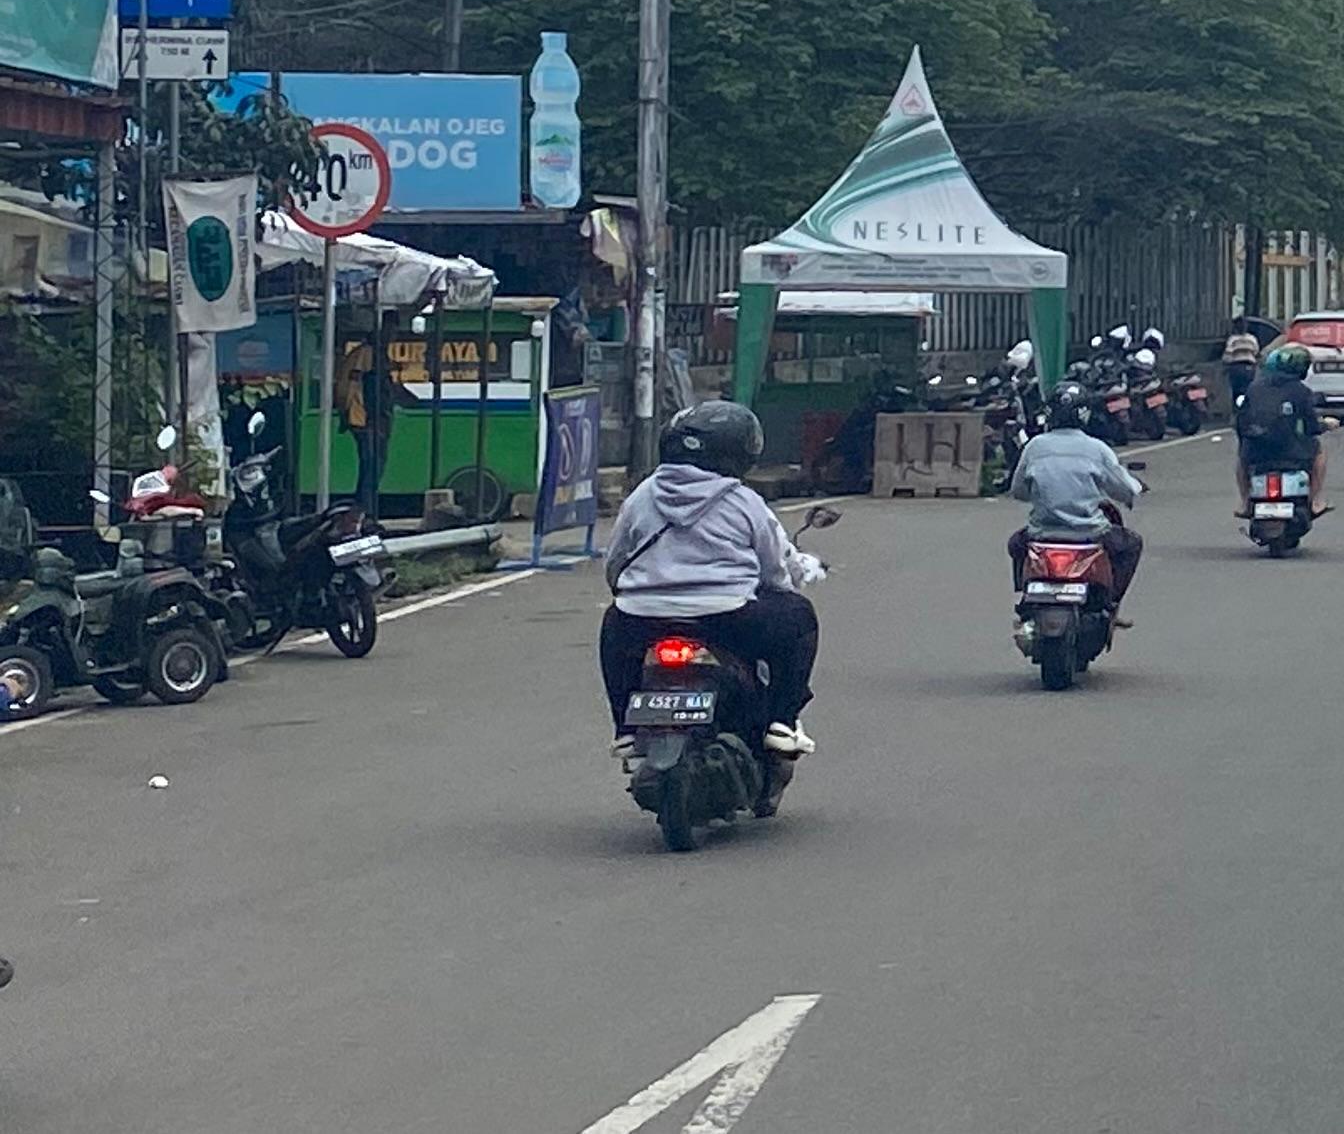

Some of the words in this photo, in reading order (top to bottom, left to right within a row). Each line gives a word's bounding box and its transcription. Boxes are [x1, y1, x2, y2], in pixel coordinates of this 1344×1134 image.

[447, 117, 505, 135] OJEG
[388, 139, 478, 169] DOG
[853, 219, 987, 245] NESLITE
